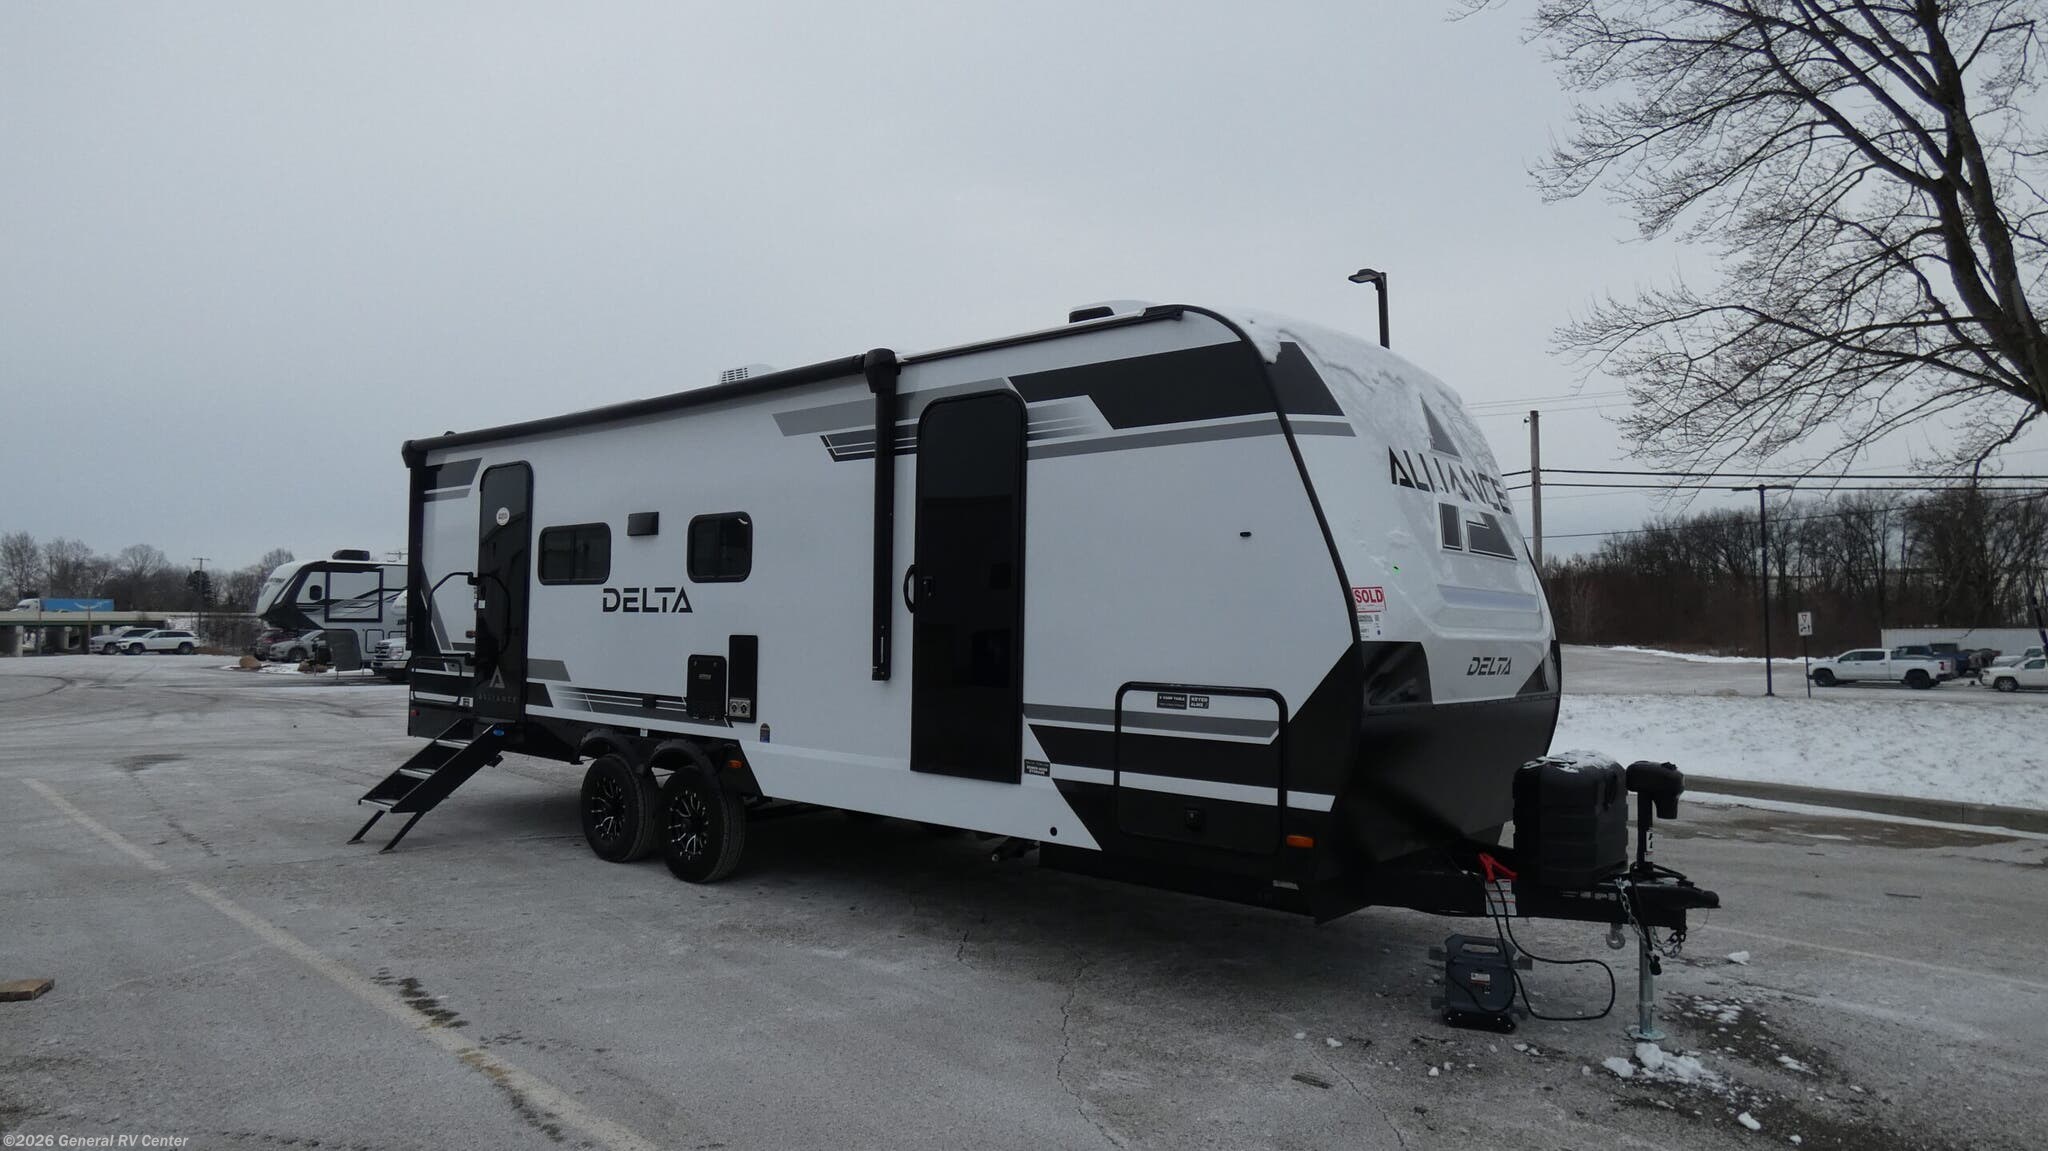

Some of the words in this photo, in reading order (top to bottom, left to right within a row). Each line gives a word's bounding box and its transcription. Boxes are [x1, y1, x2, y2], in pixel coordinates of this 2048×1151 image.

[1388, 446, 1512, 515] ALLIANCE
[602, 586, 693, 613] DELTA
[1354, 589, 1384, 604] SOLD
[1467, 656, 1512, 676] DELTA
